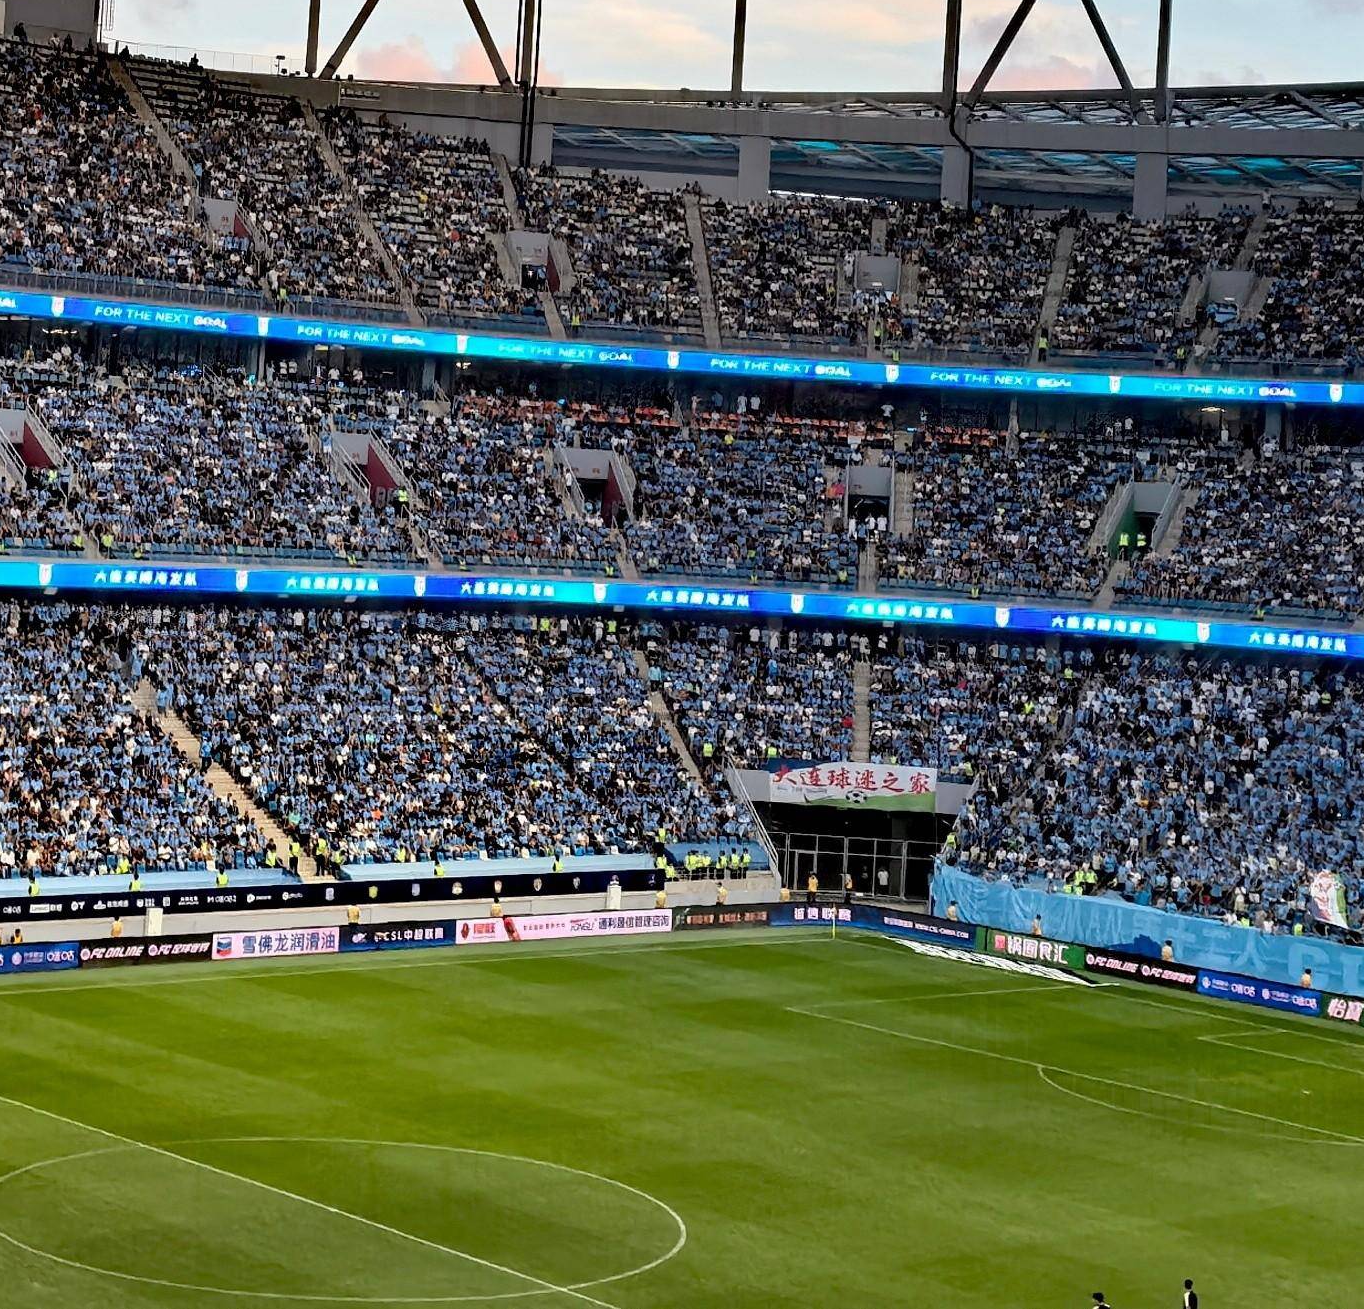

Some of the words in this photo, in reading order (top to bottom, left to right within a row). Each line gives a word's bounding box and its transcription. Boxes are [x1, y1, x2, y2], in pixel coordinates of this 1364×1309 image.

[94, 306, 122, 317] FOR
[127, 309, 151, 321] THE
[156, 312, 189, 323] NEXT
[297, 325, 322, 337] FOR
[327, 328, 350, 339] THE
[353, 330, 388, 342] NEXT
[711, 358, 738, 369] FOR
[744, 360, 770, 371] THE
[774, 363, 811, 373] NEXT
[930, 371, 958, 382] FOR
[964, 373, 990, 383] THE
[994, 375, 1032, 385] NEXT
[1154, 382, 1181, 393] FOR
[1186, 384, 1212, 394] THE
[1216, 386, 1253, 395] NEXT
[773, 765, 931, 794] 大连球迷之家
[90, 947, 103, 959] FC
[104, 944, 144, 959] ONLINE
[158, 943, 171, 955] FC
[242, 933, 336, 956] 雪佛龙润滑油
[1007, 935, 1069, 965] 锅圈食汇
